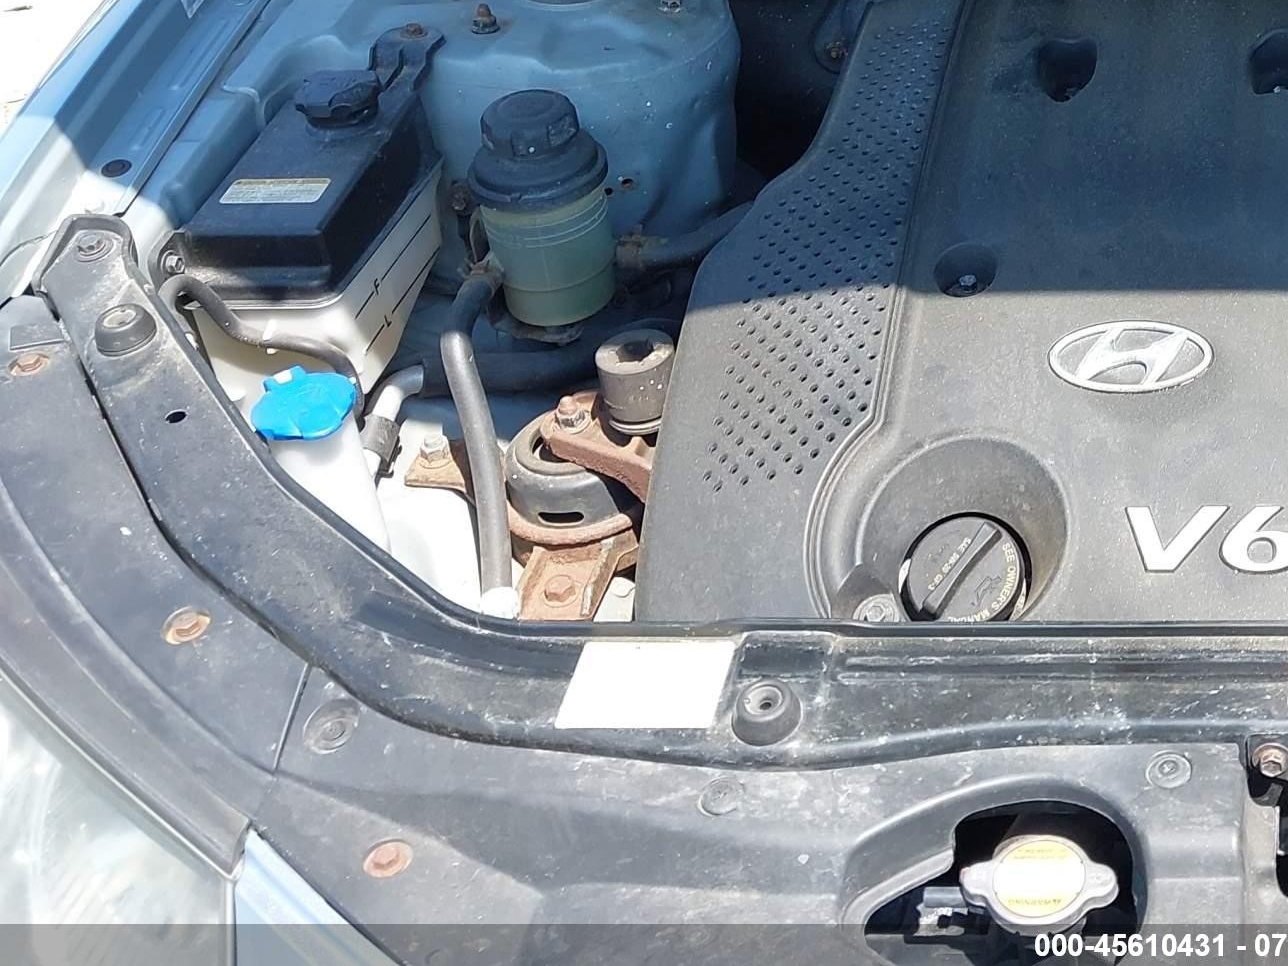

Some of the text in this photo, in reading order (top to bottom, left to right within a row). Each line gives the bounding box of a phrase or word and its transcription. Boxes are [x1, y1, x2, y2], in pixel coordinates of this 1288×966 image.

[373, 278, 380, 295] F
[384, 314, 392, 328] L
[958, 537, 972, 552] SAE
[1002, 542, 1016, 563] SEE
[991, 565, 1017, 610] OWNER'S
